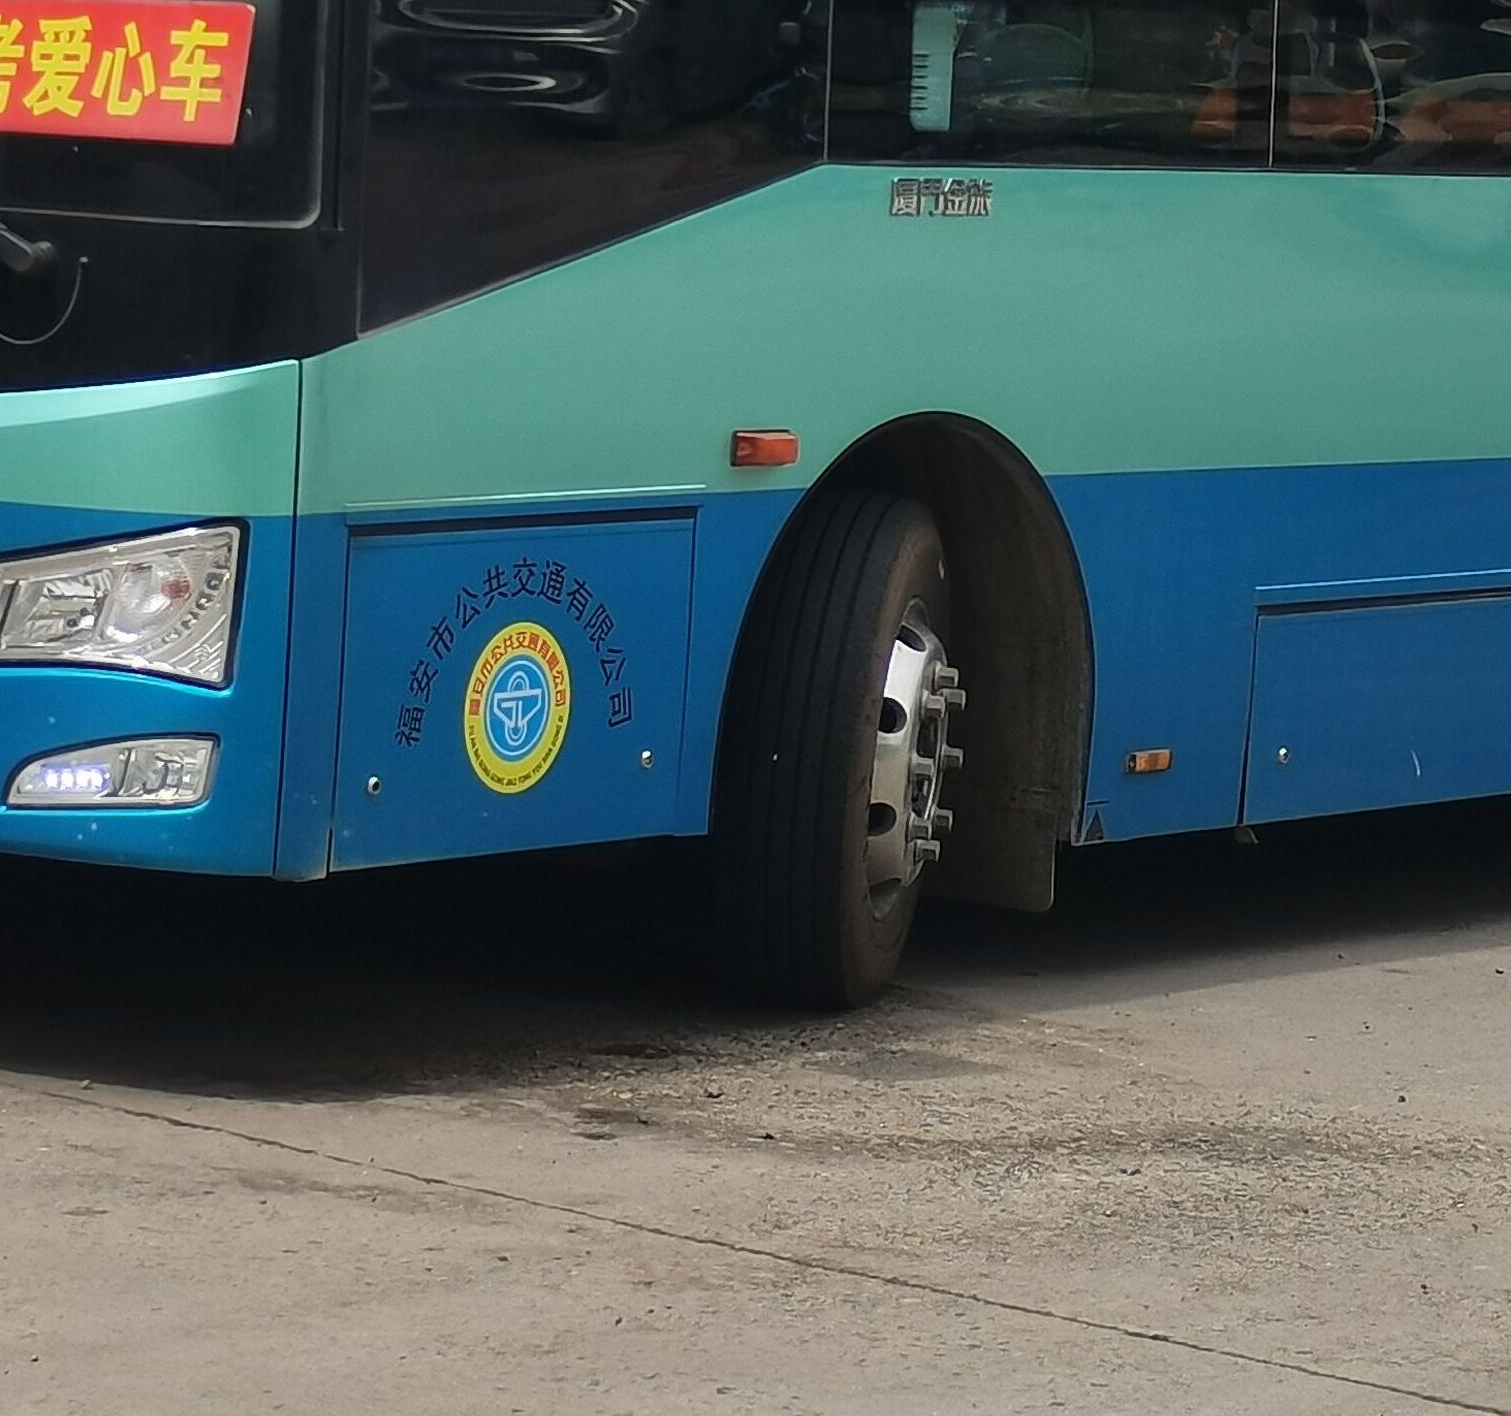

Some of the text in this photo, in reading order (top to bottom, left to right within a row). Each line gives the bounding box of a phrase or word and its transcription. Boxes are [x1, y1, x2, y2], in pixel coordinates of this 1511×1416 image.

[394, 556, 634, 749] 福安市公共交通有限公司
